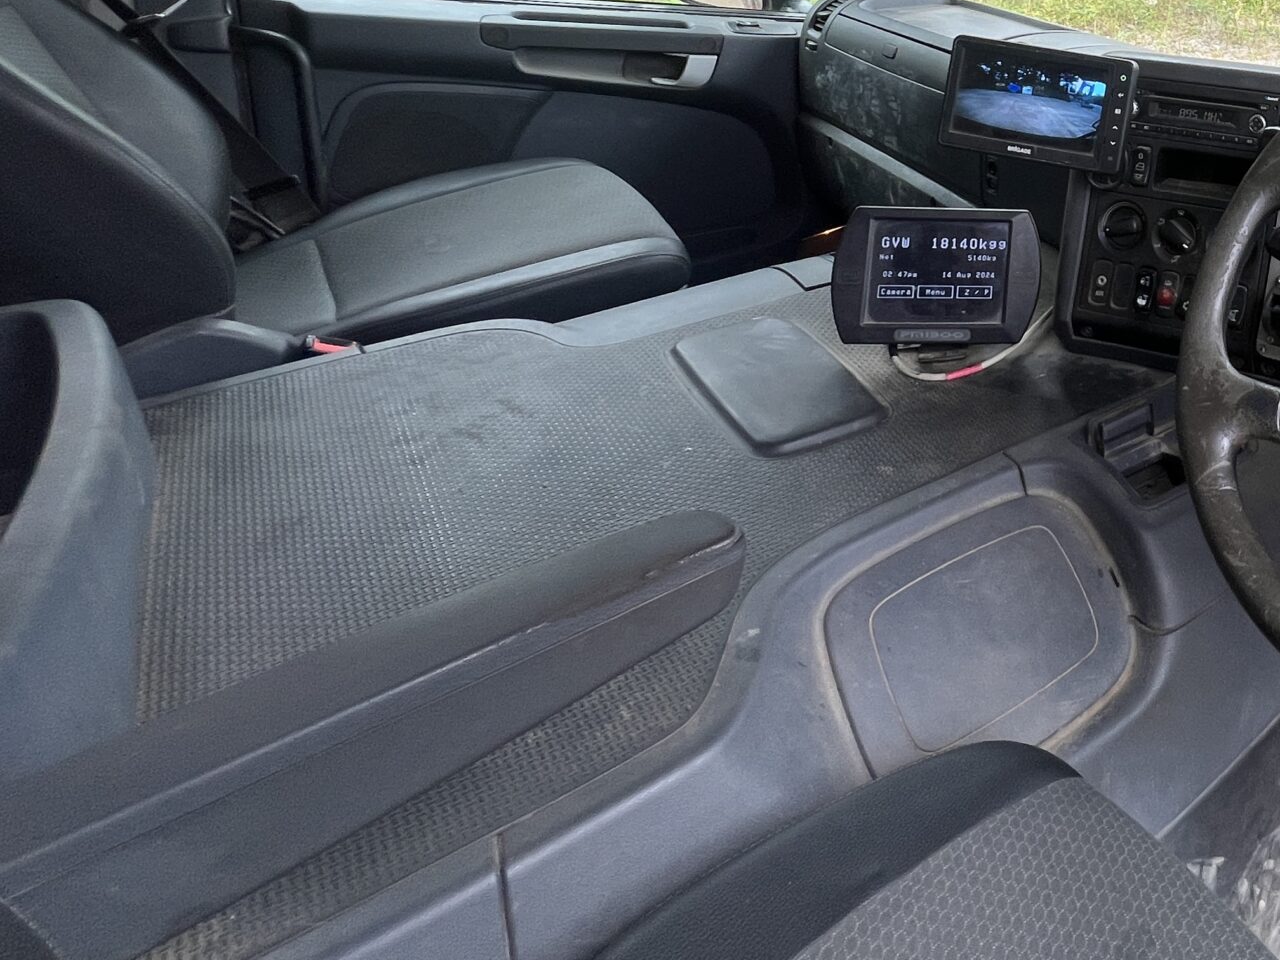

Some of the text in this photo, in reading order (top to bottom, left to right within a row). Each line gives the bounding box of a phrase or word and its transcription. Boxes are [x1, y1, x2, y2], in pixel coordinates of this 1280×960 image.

[881, 236, 911, 249] GVW
[956, 271, 971, 279] Aug
[976, 271, 995, 279] 2024
[880, 288, 912, 296] Camera
[925, 288, 946, 296] Menu
